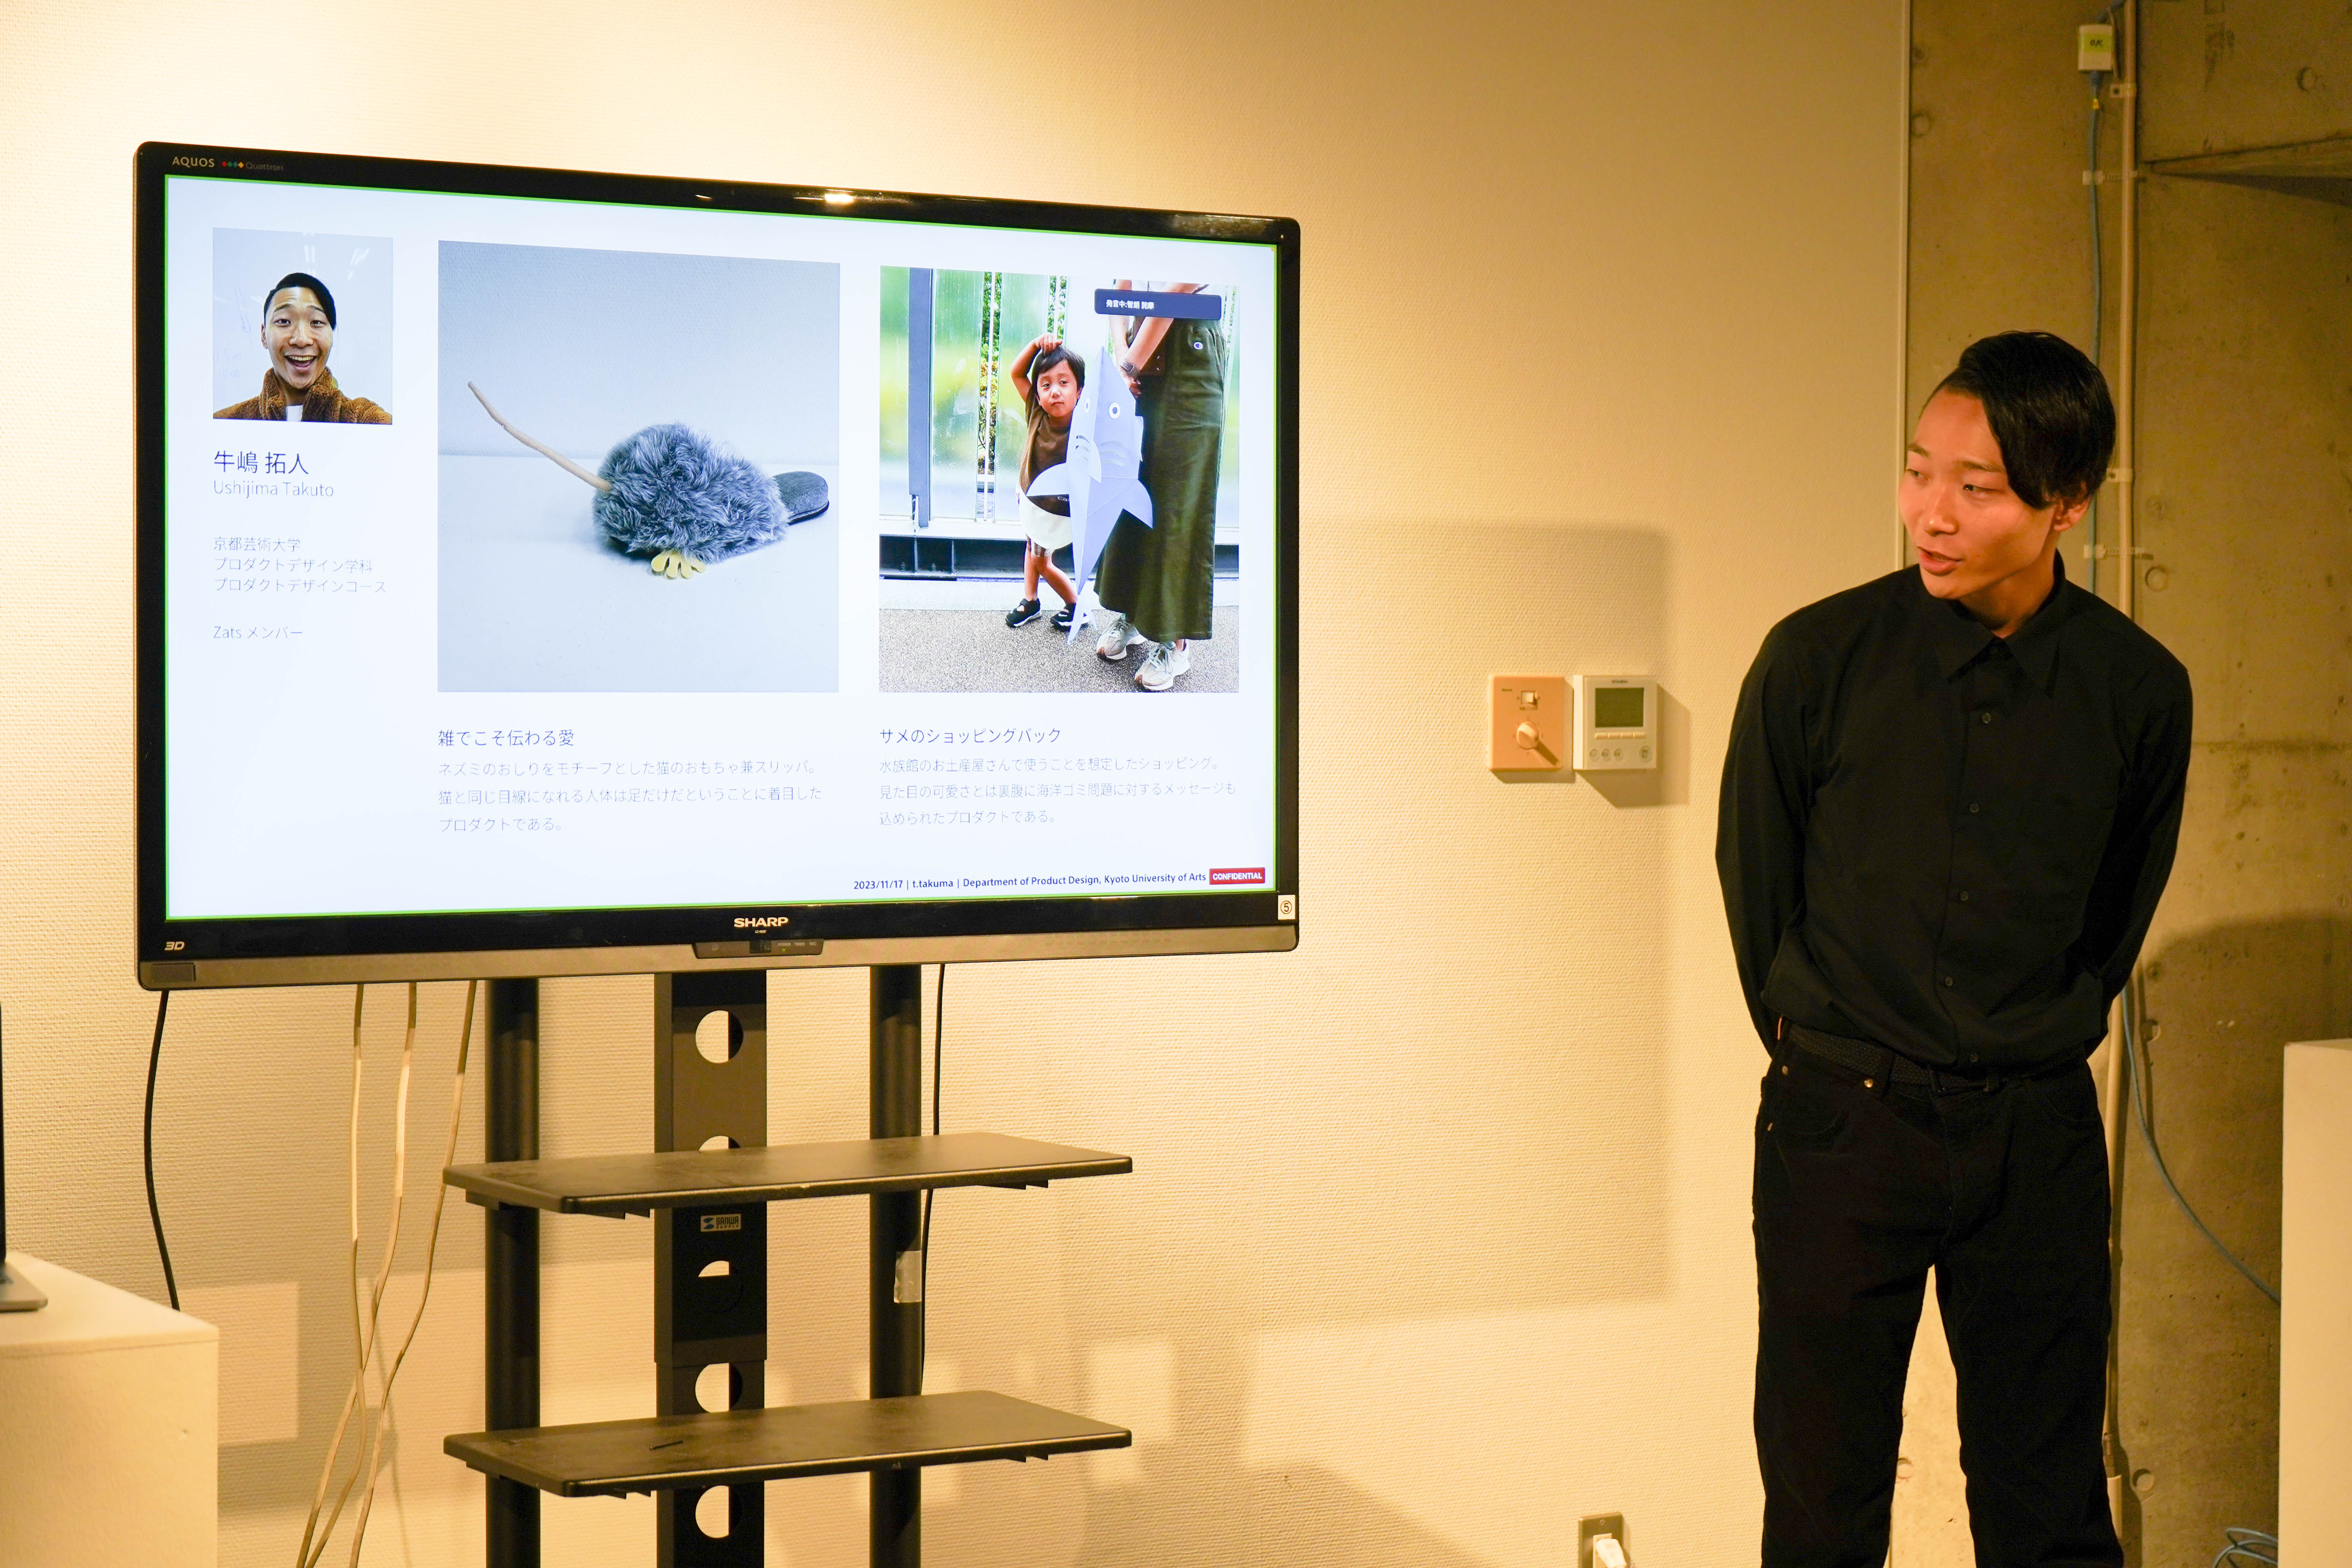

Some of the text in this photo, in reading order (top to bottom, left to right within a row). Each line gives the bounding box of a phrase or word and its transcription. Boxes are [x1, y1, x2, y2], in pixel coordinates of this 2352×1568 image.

[172, 156, 283, 171] AQUOS Quattron
[214, 450, 309, 475] 牛嶋 拓人
[214, 479, 334, 499] Ushijima Takuto
[214, 536, 300, 552] 京都芸術大学
[215, 557, 372, 573] プロダクトデザイン学科
[215, 577, 386, 593] プロダクトデザインコース
[213, 626, 303, 639] Zats メンバー
[438, 729, 574, 747] 雑でこそ伝わる愛
[880, 728, 1060, 744] サメのショッピングバック
[439, 760, 814, 777] ネズミのおしりをモチーフとした猫のおもちゃ兼スリッパ。
[879, 756, 1217, 773] 水族館のお土産屋さんで使うことを想定したショッピング。
[438, 786, 821, 805] 猫と同じ目線になれる人体は足だけだということに着目した
[880, 782, 1236, 799] 見た目の可愛さとは裏腹に海洋ゴミ問題に対するメッセージも
[439, 817, 561, 832] プロダクトである。
[879, 810, 1054, 826] 込められたプロダクトである。
[853, 880, 903, 889] 2023/11/17
[912, 879, 953, 888] t.takuma
[963, 878, 1017, 889] Department
[1020, 877, 1029, 886] of
[1031, 876, 1066, 885] Product
[1069, 875, 1101, 886] Design,
[1104, 875, 1129, 885] Kyoto
[1132, 873, 1176, 884] University
[1178, 873, 1187, 881] of
[1212, 872, 1263, 880] CONFIDENTIAL
[733, 916, 788, 927] SHARP
[164, 941, 185, 951] 3D
[716, 1216, 739, 1225] SANWA
